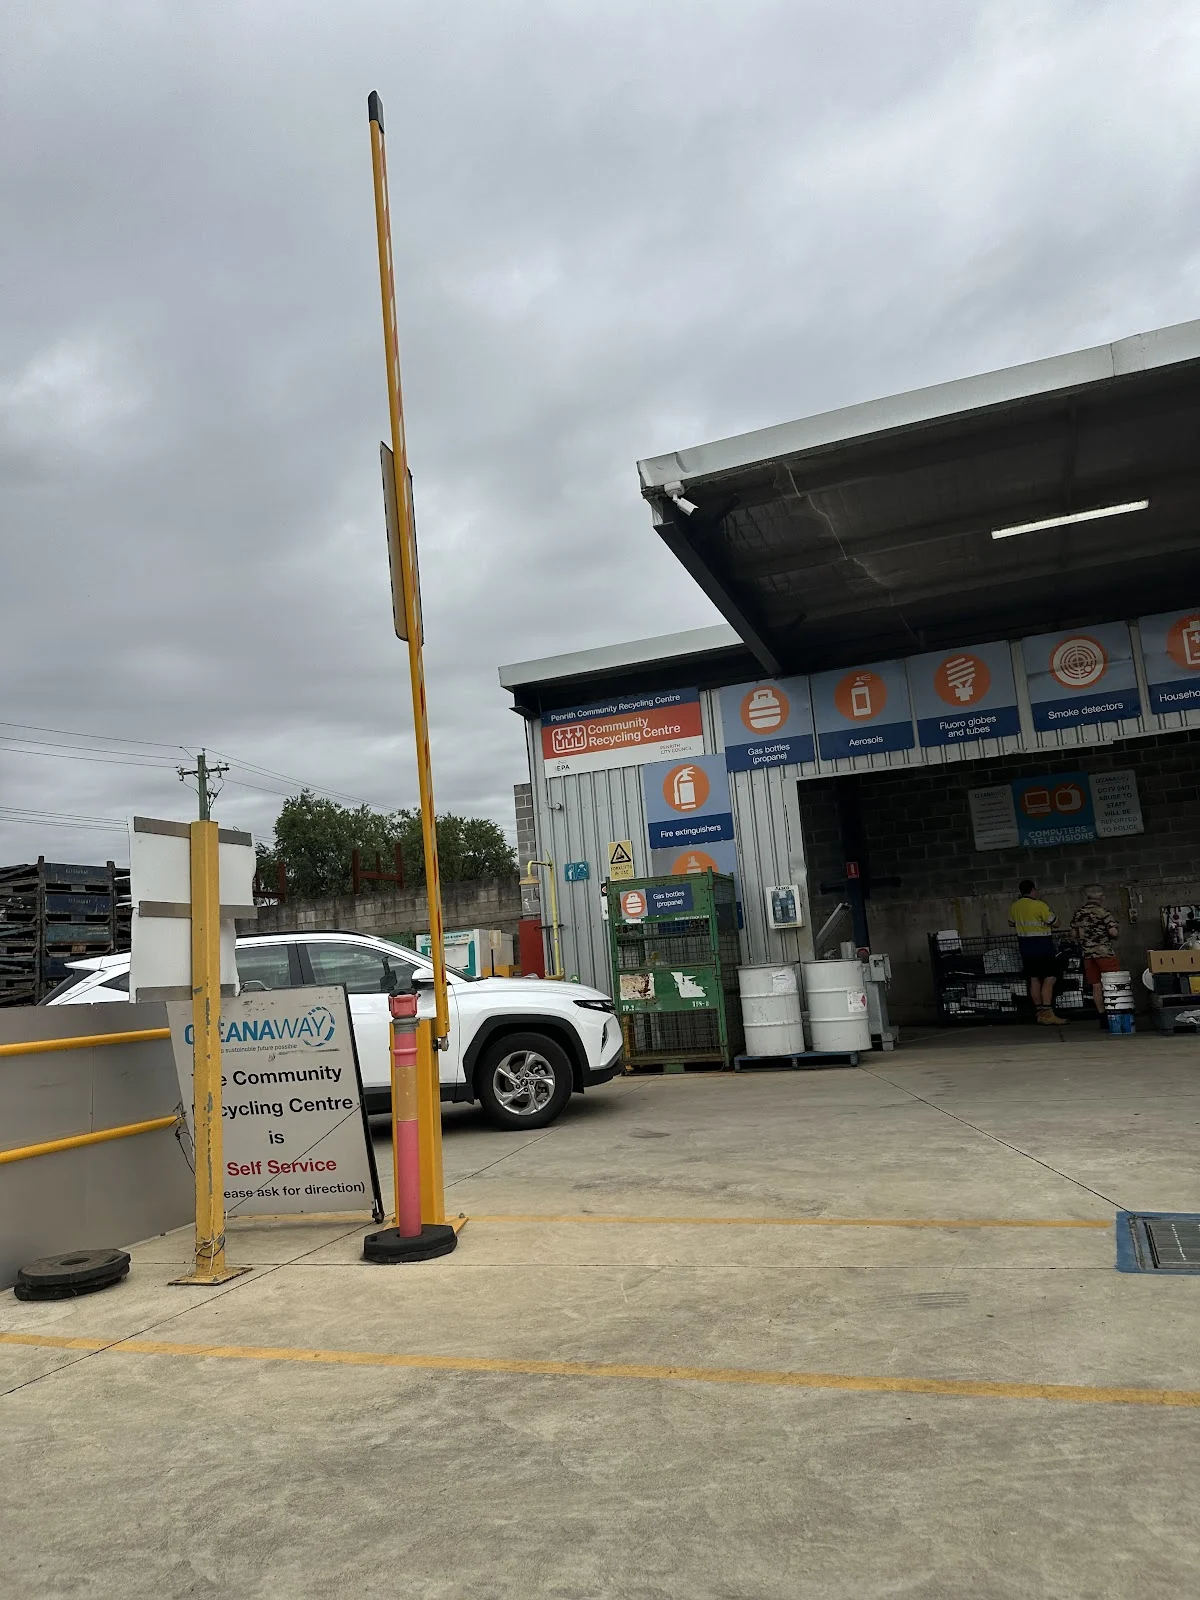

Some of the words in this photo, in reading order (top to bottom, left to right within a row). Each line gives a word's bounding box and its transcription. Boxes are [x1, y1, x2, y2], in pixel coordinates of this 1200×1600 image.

[551, 711, 576, 723] Penrith
[577, 706, 618, 718] Community
[618, 699, 654, 711] Recycling
[654, 694, 681, 704] Centre
[1048, 708, 1079, 720] Smoke
[1081, 701, 1124, 714] detectors
[587, 716, 649, 735] Community
[939, 719, 966, 730] Fluoro
[967, 715, 997, 728] globes
[589, 730, 642, 747] Recycling
[642, 724, 681, 738] Centre
[948, 728, 965, 738] and
[966, 725, 991, 736] tubes
[849, 735, 883, 747] Aerosols
[747, 747, 763, 756] Gas
[763, 743, 791, 753] bottles
[752, 752, 788, 764] (propane)
[1097, 786, 1116, 794] CCTV
[1116, 784, 1131, 792] 24/7
[1106, 801, 1127, 809] STAFF
[1104, 809, 1120, 817] WILL
[1100, 816, 1138, 825] REPORTED
[660, 829, 674, 838] Fire
[675, 823, 722, 837] extinguishers
[1028, 825, 1087, 838] COMPUTERS
[1113, 824, 1138, 832] POLICE
[1023, 838, 1030, 846] &
[1032, 832, 1095, 845] TELEVISIONS
[652, 892, 665, 900] Gas
[665, 889, 685, 899] bottles
[656, 898, 684, 909] (propane)
[184, 1015, 327, 1045] CANAWAY
[257, 1045, 274, 1053] future
[274, 1043, 298, 1051] possible
[232, 1065, 342, 1086] Community
[192, 1100, 284, 1120] cycling
[288, 1095, 353, 1113] Centre
[268, 1130, 285, 1144] is
[226, 1161, 262, 1177] Self
[267, 1158, 337, 1175] Service
[256, 1186, 280, 1197] ask
[282, 1185, 301, 1196] for
[304, 1181, 366, 1195] direction)
